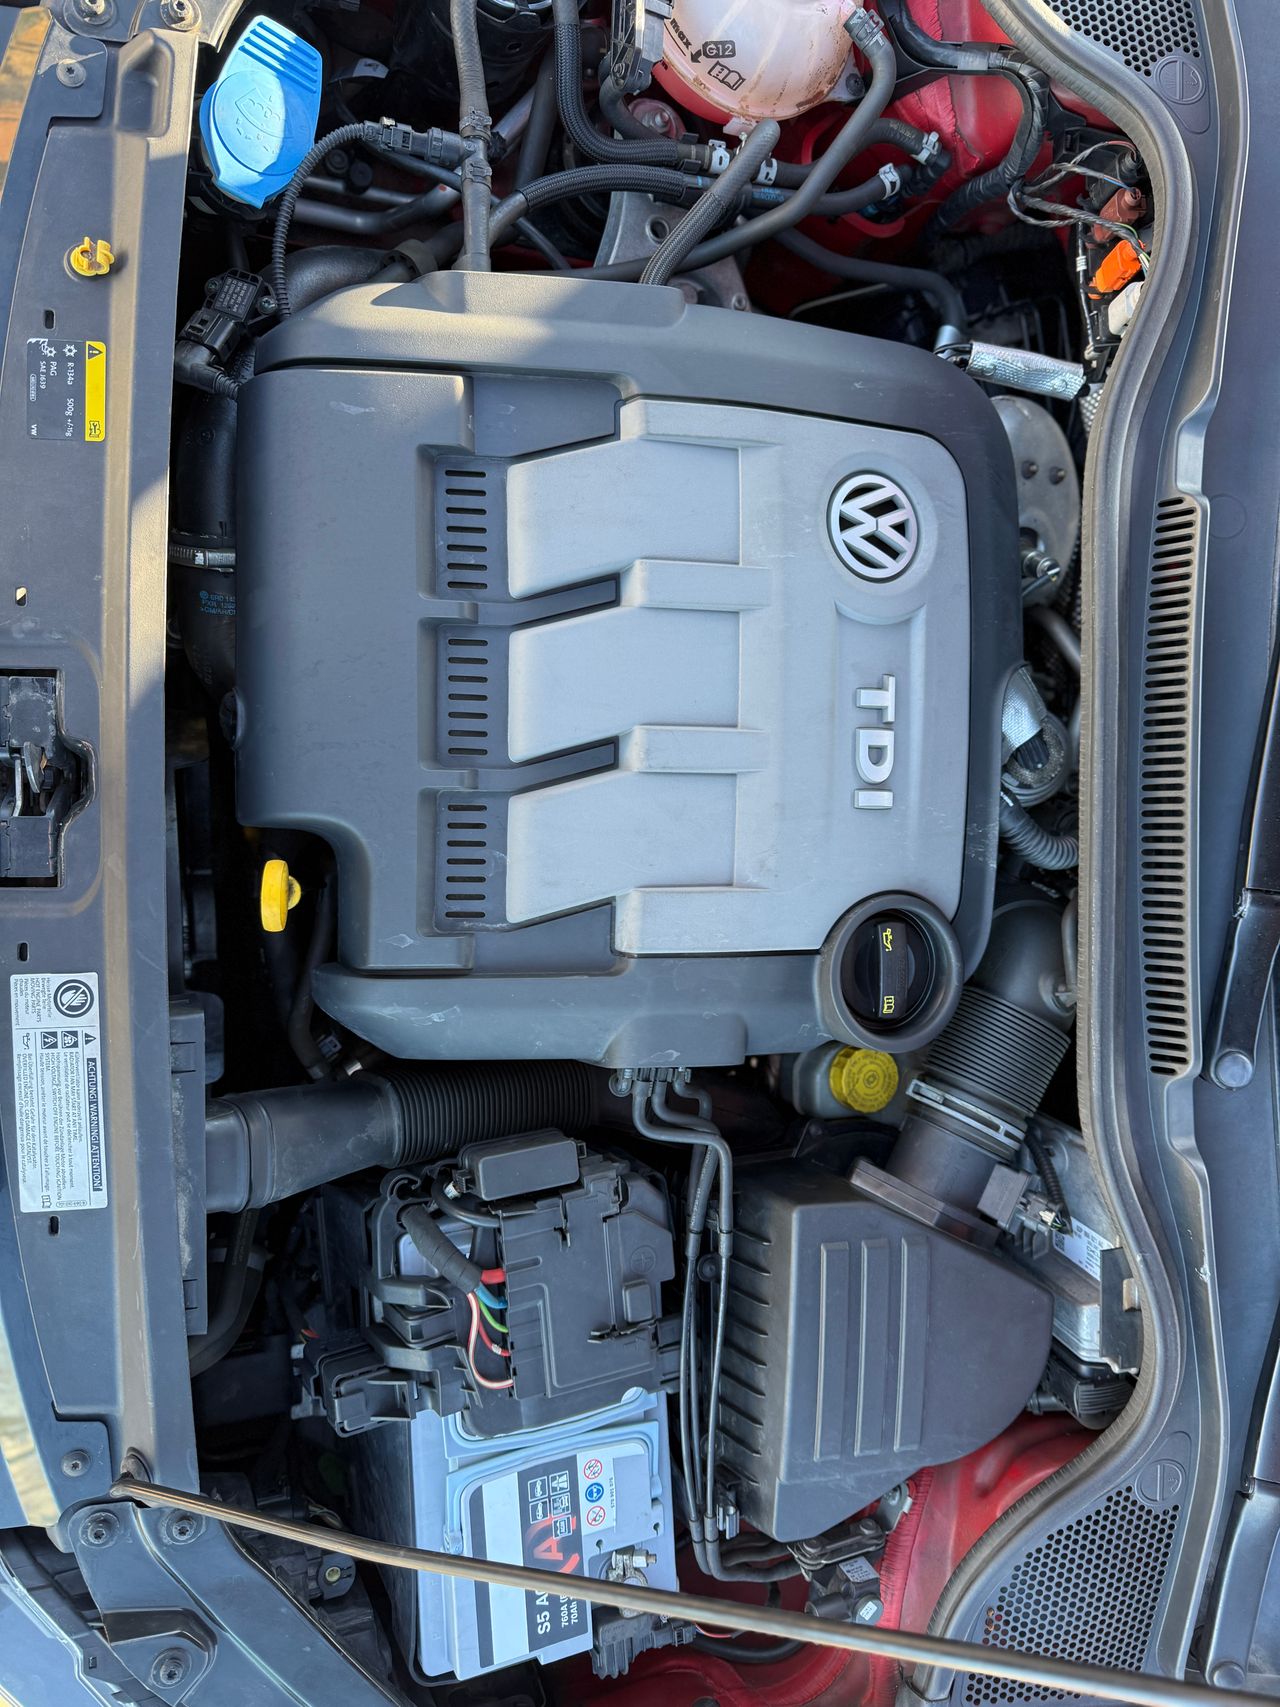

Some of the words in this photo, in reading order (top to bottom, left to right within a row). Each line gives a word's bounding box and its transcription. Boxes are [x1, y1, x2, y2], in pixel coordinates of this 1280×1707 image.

[670, 18, 692, 49] max
[706, 44, 732, 55] G12
[65, 398, 74, 416] 500g
[31, 424, 37, 436] VW
[853, 673, 896, 810] TDI
[88, 1061, 98, 1102] ACHTUNG!
[89, 1103, 99, 1144] WARNING!
[91, 1145, 101, 1189] ATTENTION!
[538, 1610, 550, 1635] S5
[561, 1603, 569, 1627] 760A
